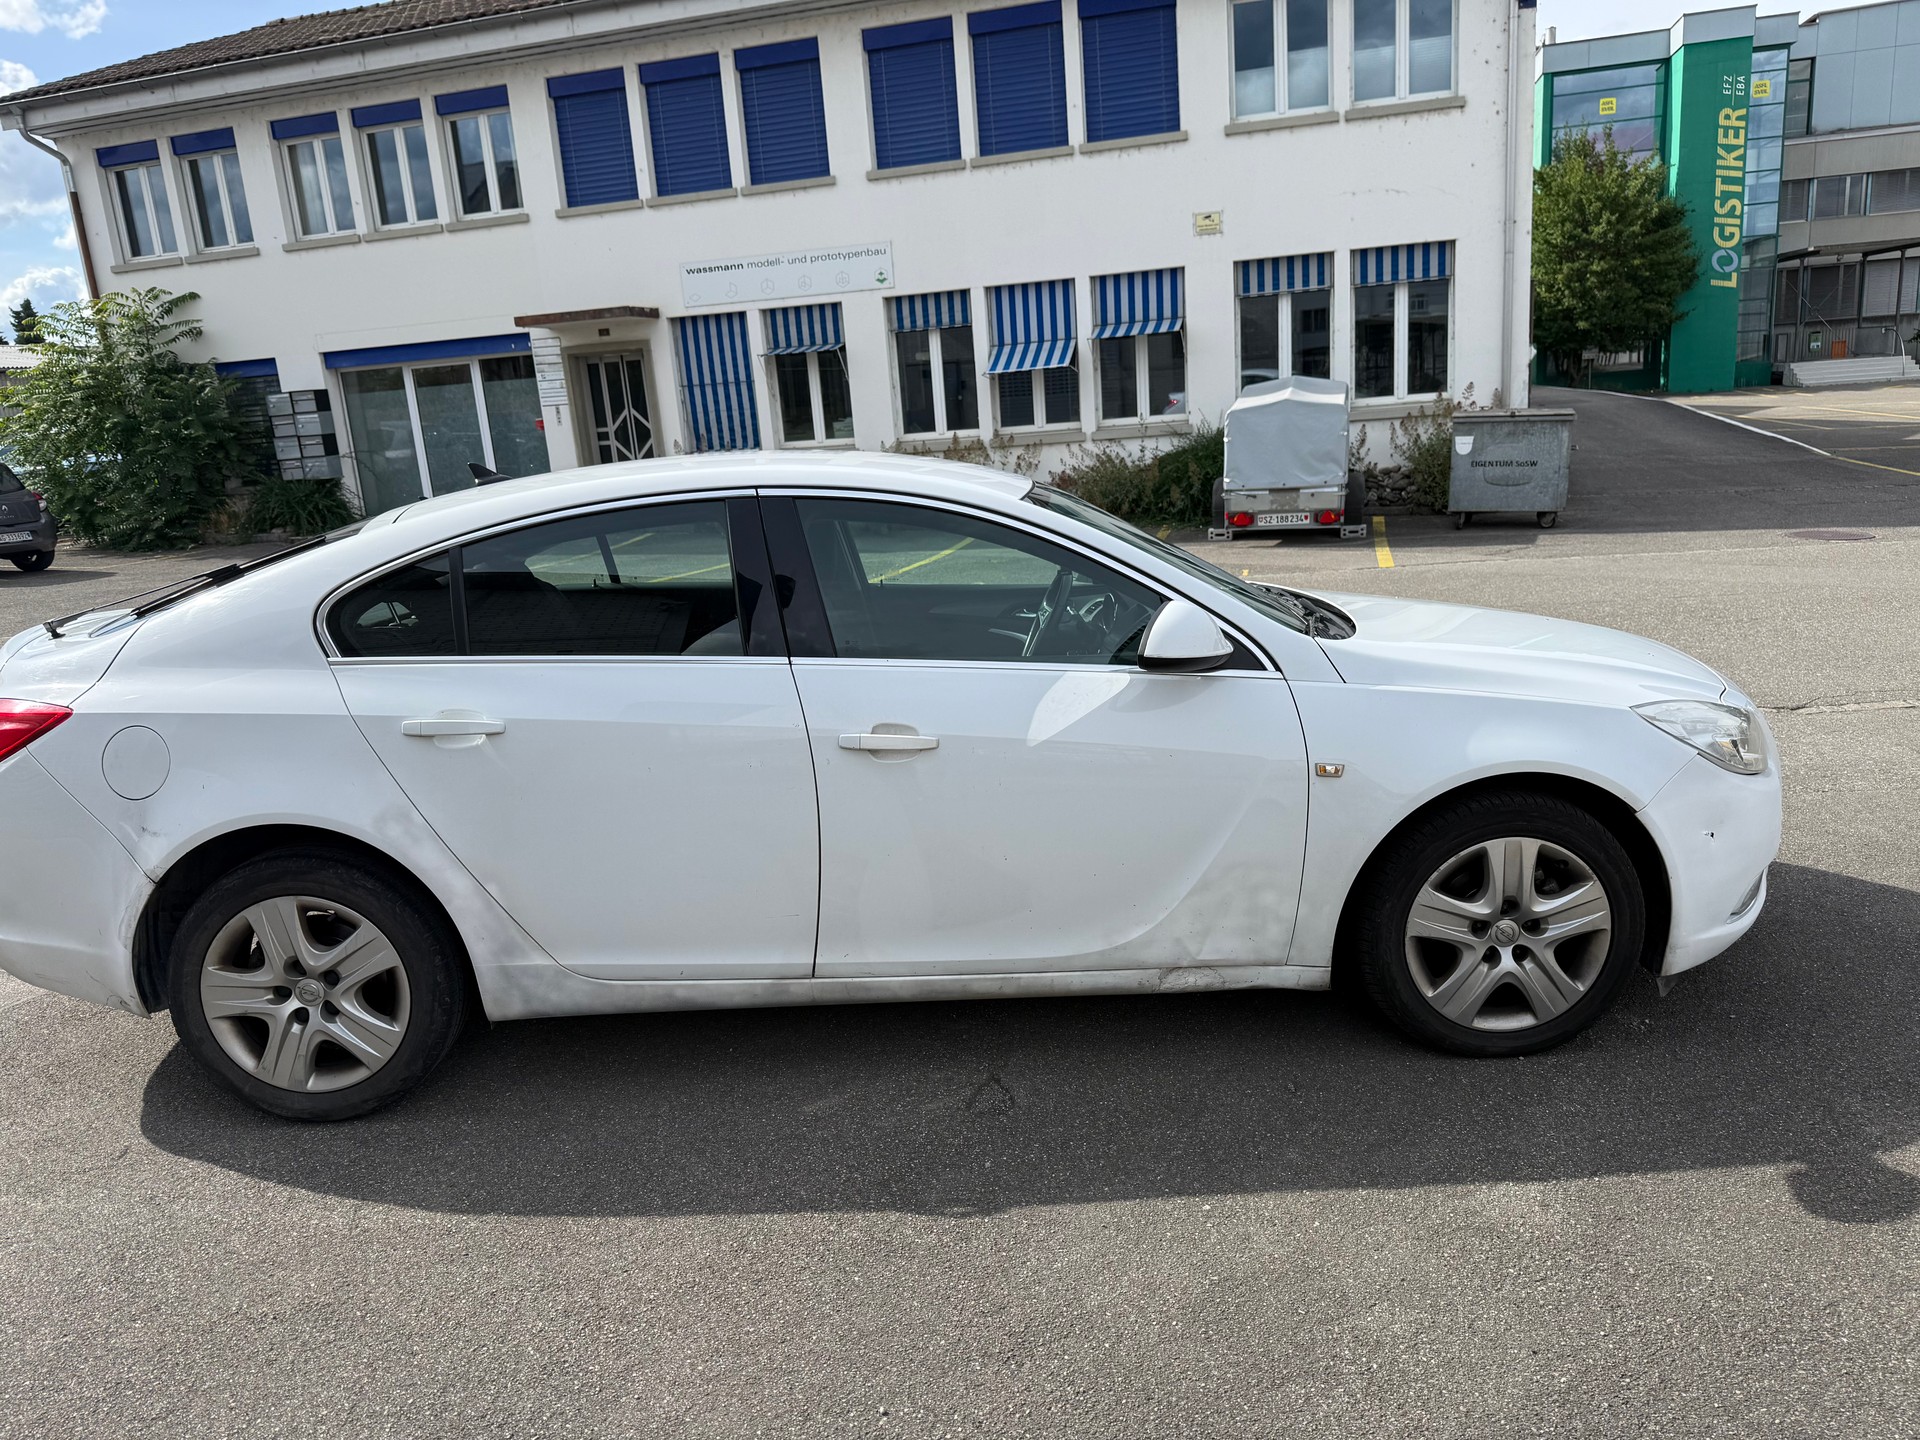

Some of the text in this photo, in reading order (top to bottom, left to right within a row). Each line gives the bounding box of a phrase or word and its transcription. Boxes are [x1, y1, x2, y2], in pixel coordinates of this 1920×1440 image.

[1723, 75, 1733, 95] EFZ
[1736, 75, 1746, 96] EBA
[1711, 107, 1747, 288] LOGISTIKER
[685, 247, 887, 275] wassmann modell- und prototypenbau
[1471, 460, 1513, 468] EIGENTUM
